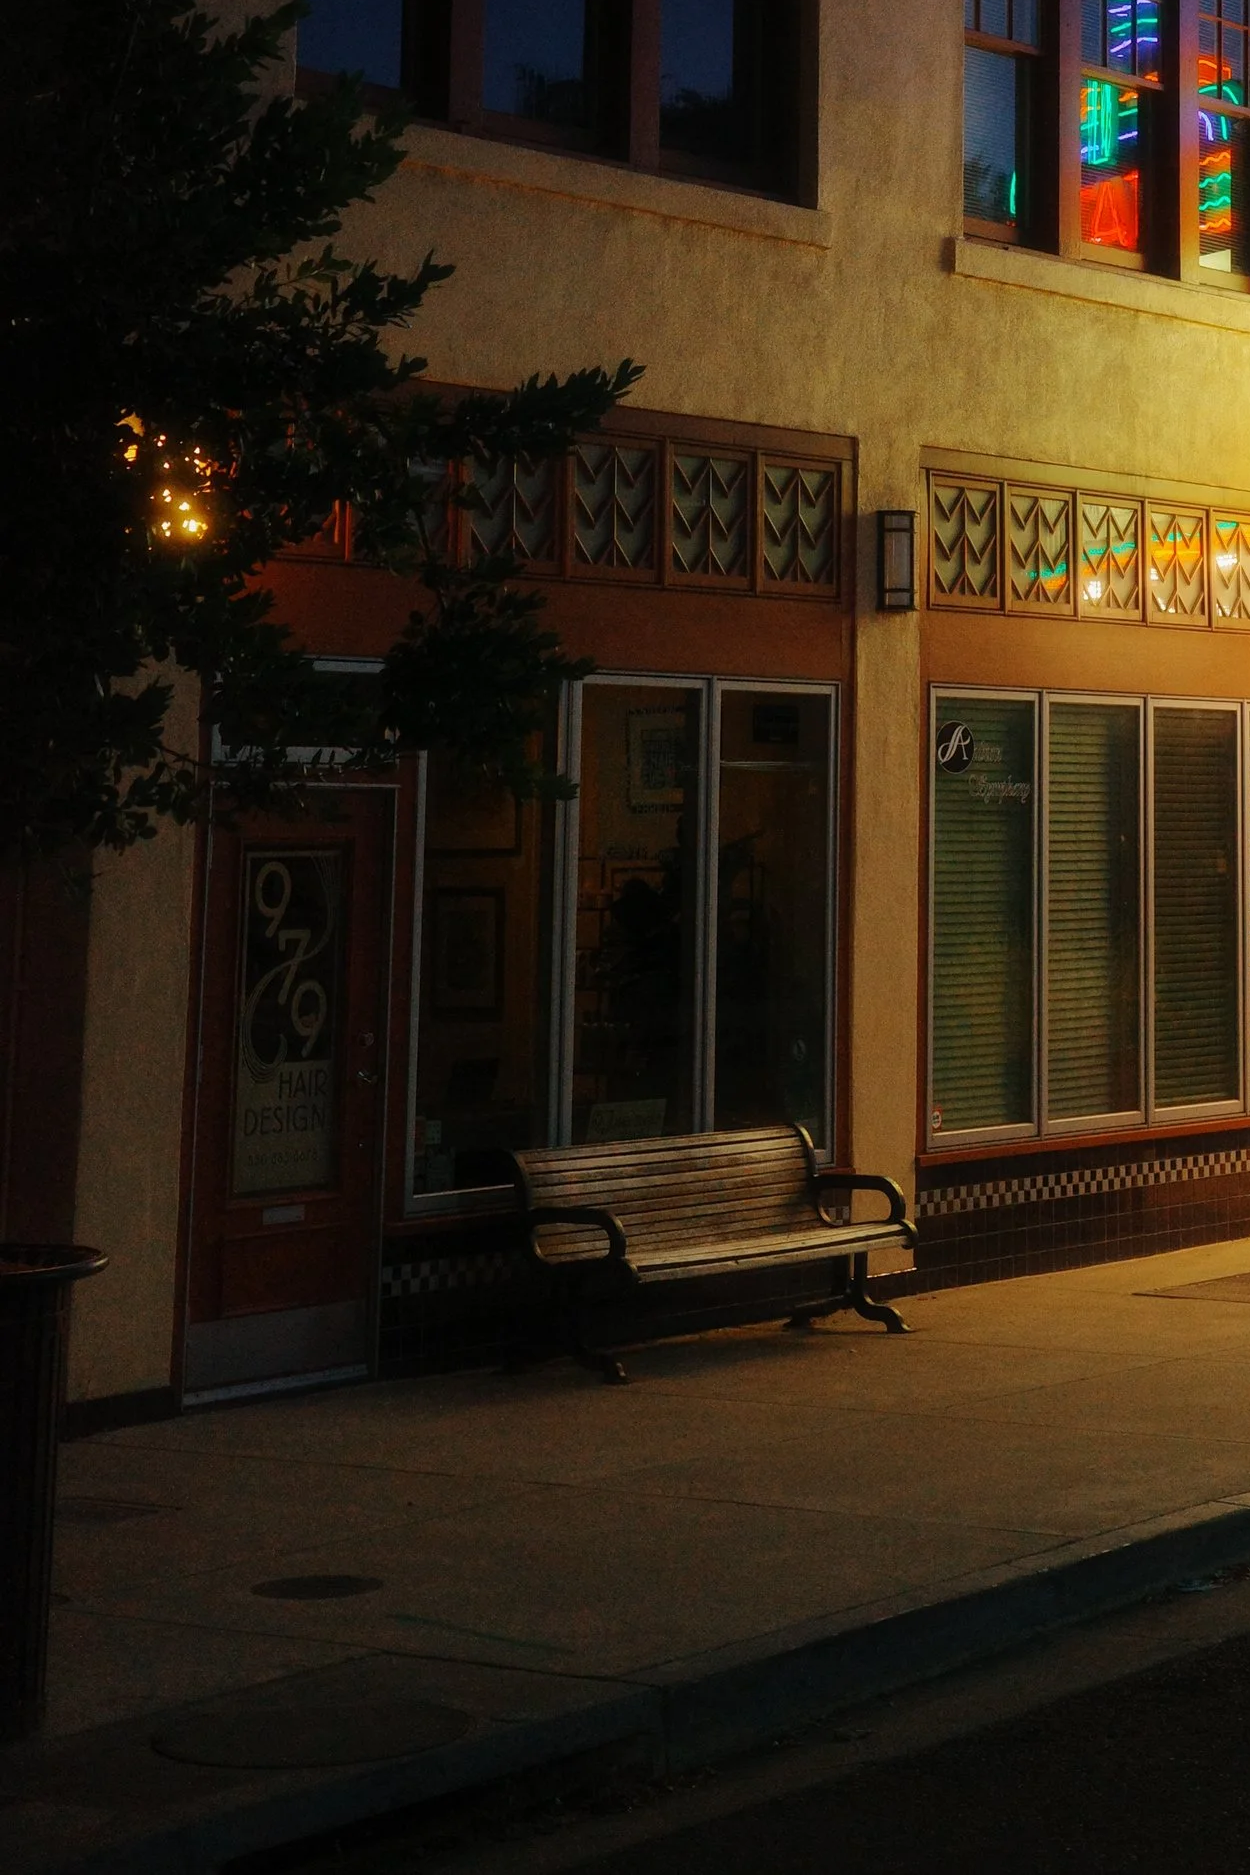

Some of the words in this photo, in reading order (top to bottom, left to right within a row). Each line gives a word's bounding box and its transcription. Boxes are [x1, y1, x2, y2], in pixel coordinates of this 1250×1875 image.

[254, 860, 328, 1059] 979
[278, 1068, 328, 1100] HAIR
[243, 1104, 327, 1137] DESIGN
